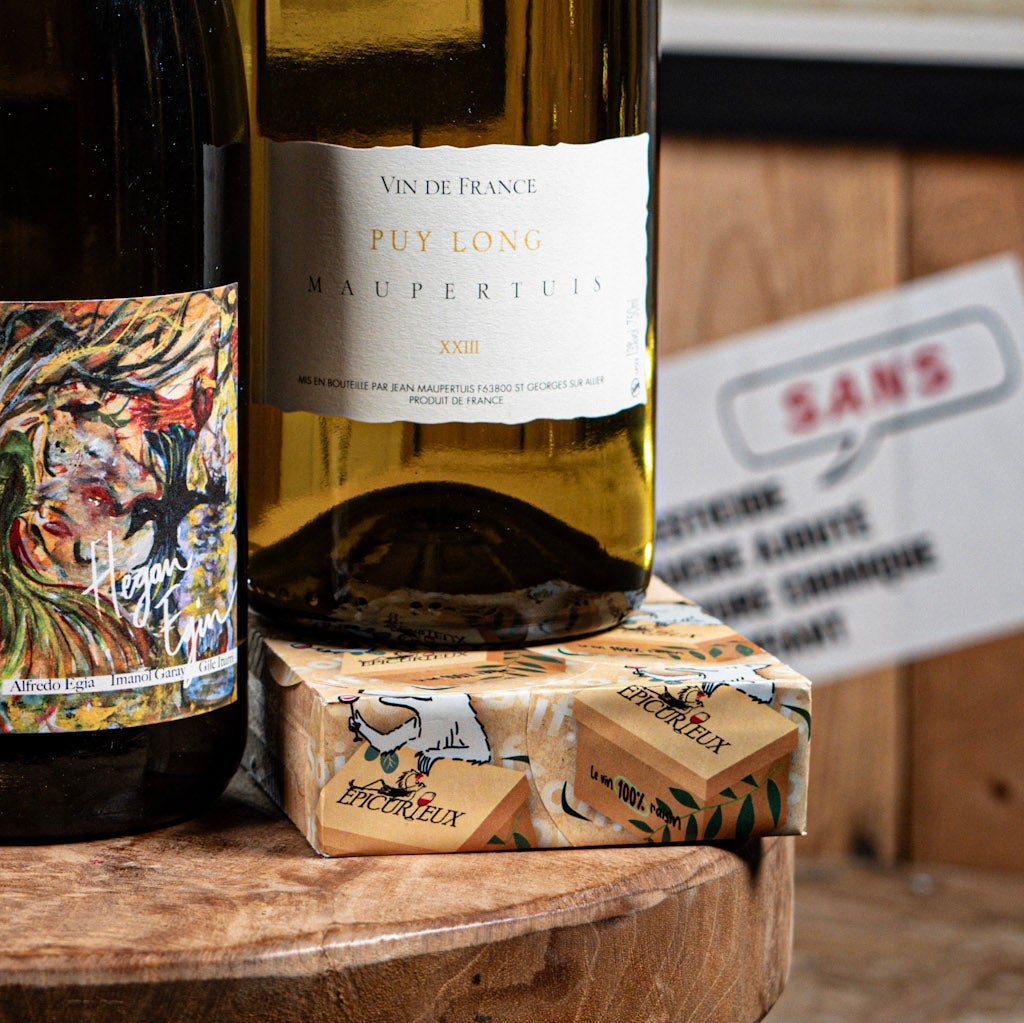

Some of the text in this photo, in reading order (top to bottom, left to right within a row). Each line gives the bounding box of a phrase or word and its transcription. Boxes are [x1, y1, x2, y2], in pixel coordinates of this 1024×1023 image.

[380, 176, 417, 195] VIN
[460, 178, 537, 195] FRANCE
[371, 229, 542, 253] PUY LONG
[308, 276, 602, 300] MAUPERTUIS
[439, 340, 480, 355] XXIII
[298, 375, 604, 394] MIS EN BOUTEILLE PAR JEAN MAUPERTUIS F63800 ST GEORGES SUR ALLIER
[784, 345, 951, 434] SANS
[409, 395, 504, 405] PRODUIT DE FRANCE
[82, 530, 194, 628] Hegan
[10, 680, 61, 693] Alfredo
[65, 678, 95, 693] Egia
[111, 673, 152, 687] Imanol
[155, 664, 186, 680] Garay
[617, 684, 732, 755] EPICURIEUX
[336, 786, 467, 828] EPICURIEUX
[600, 772, 614, 791] vin
[617, 780, 646, 812] 100%
[649, 801, 682, 831] raisin
